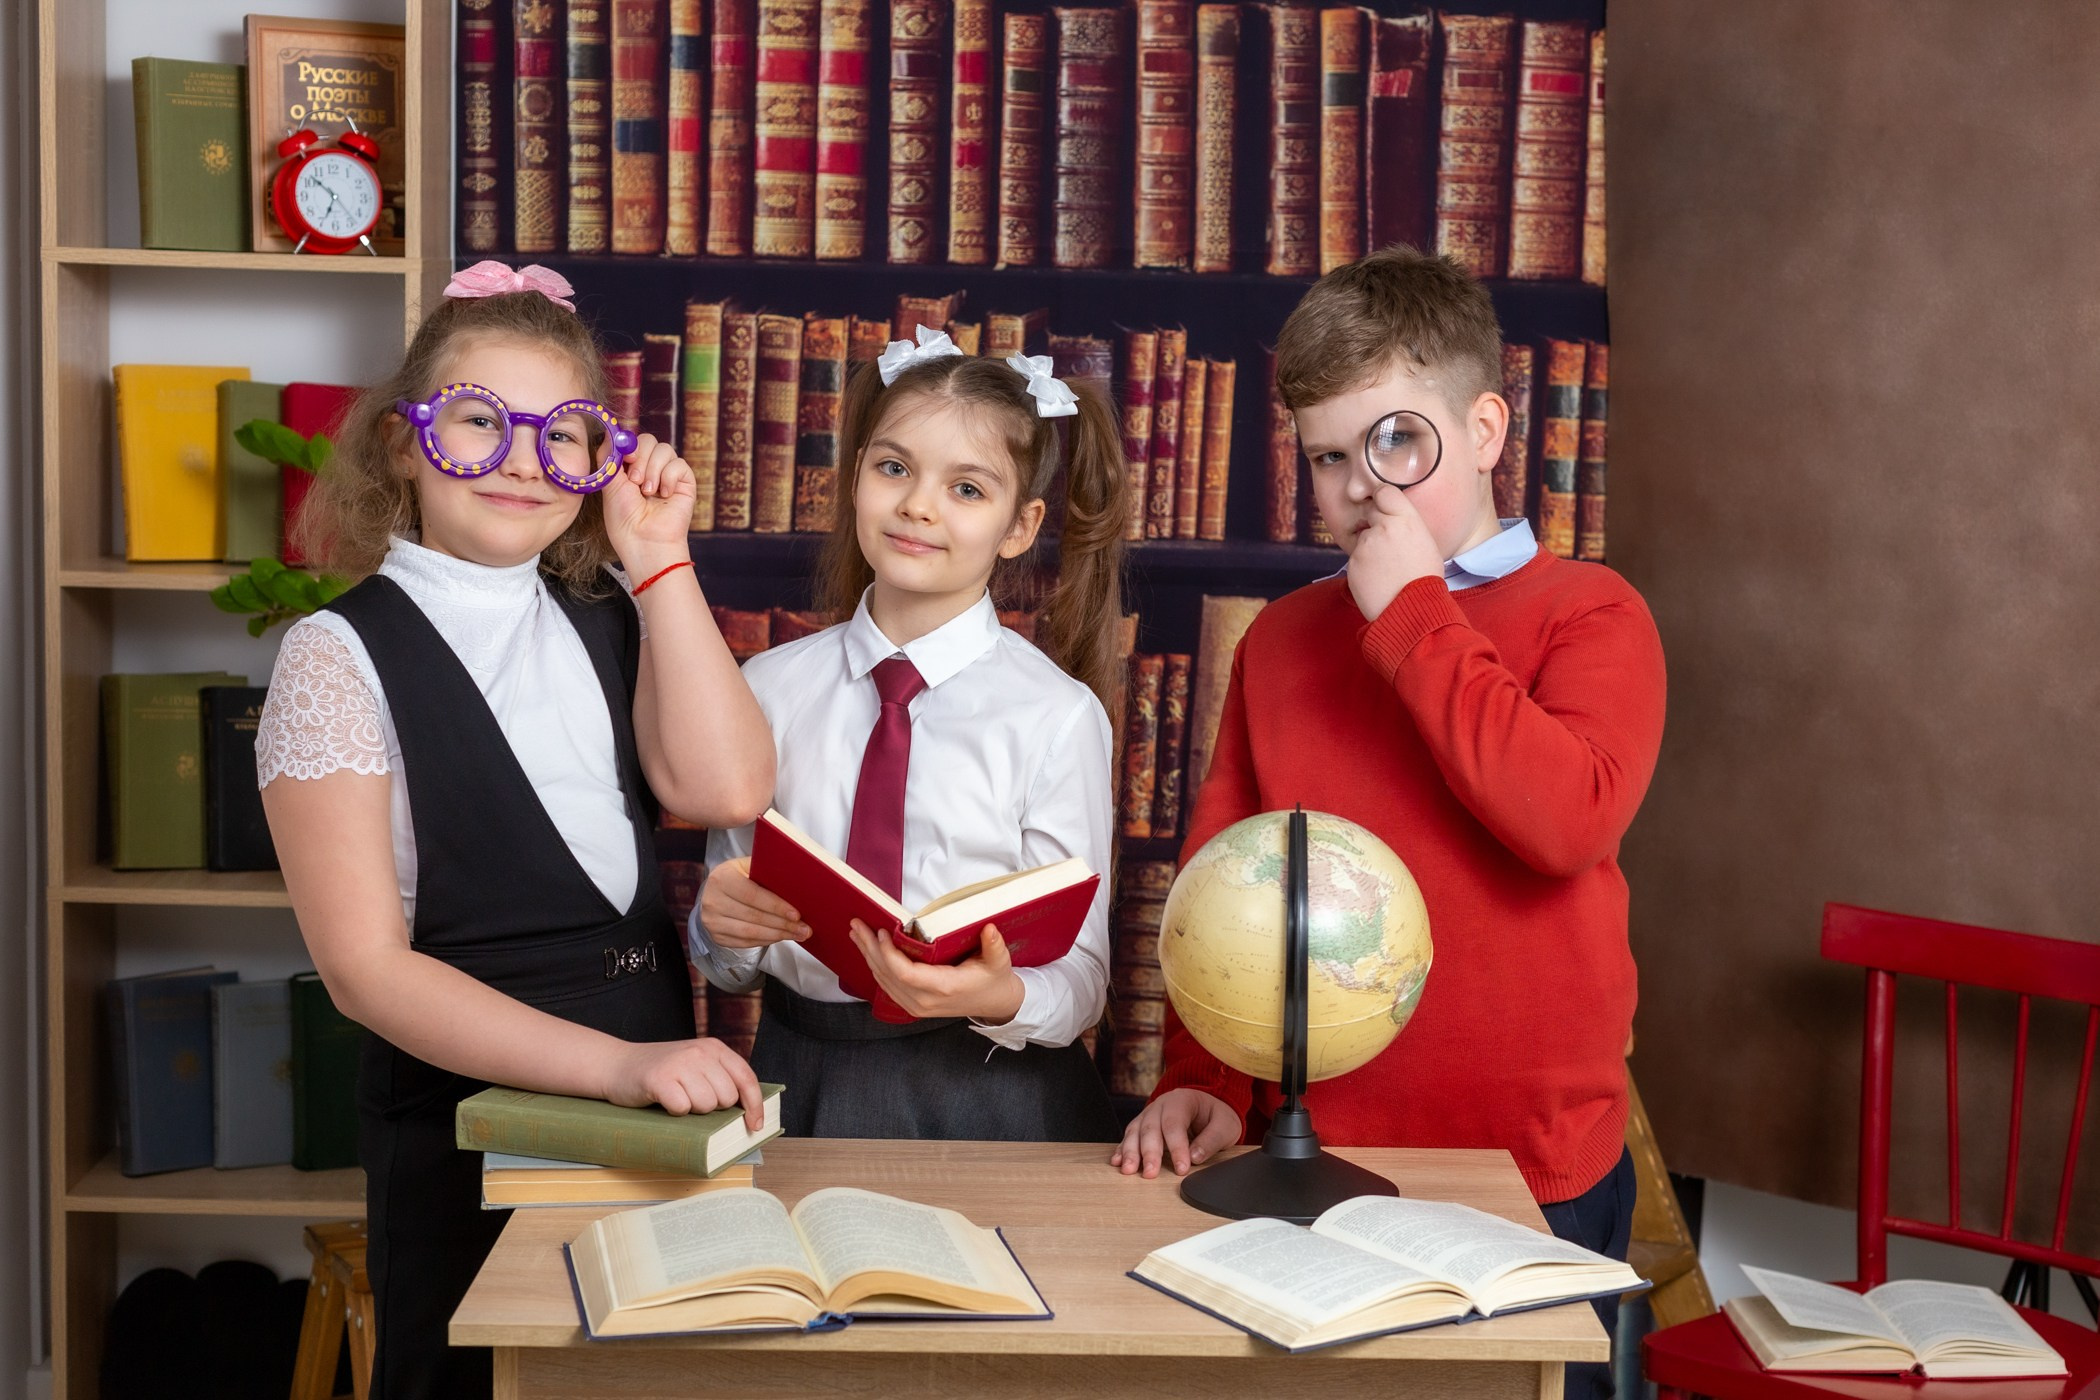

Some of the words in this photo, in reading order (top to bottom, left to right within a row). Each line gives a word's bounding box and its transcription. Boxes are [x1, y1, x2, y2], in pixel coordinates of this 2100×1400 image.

[314, 166, 323, 177] 11
[328, 164, 339, 174] 12
[346, 167, 350, 178] 1
[304, 177, 316, 188] 10
[354, 179, 362, 189] 2
[300, 191, 308, 202] 9
[359, 193, 368, 204] 3
[306, 206, 314, 216] 8
[355, 208, 362, 218] 4
[332, 221, 340, 232] 6
[346, 216, 354, 228] 5
